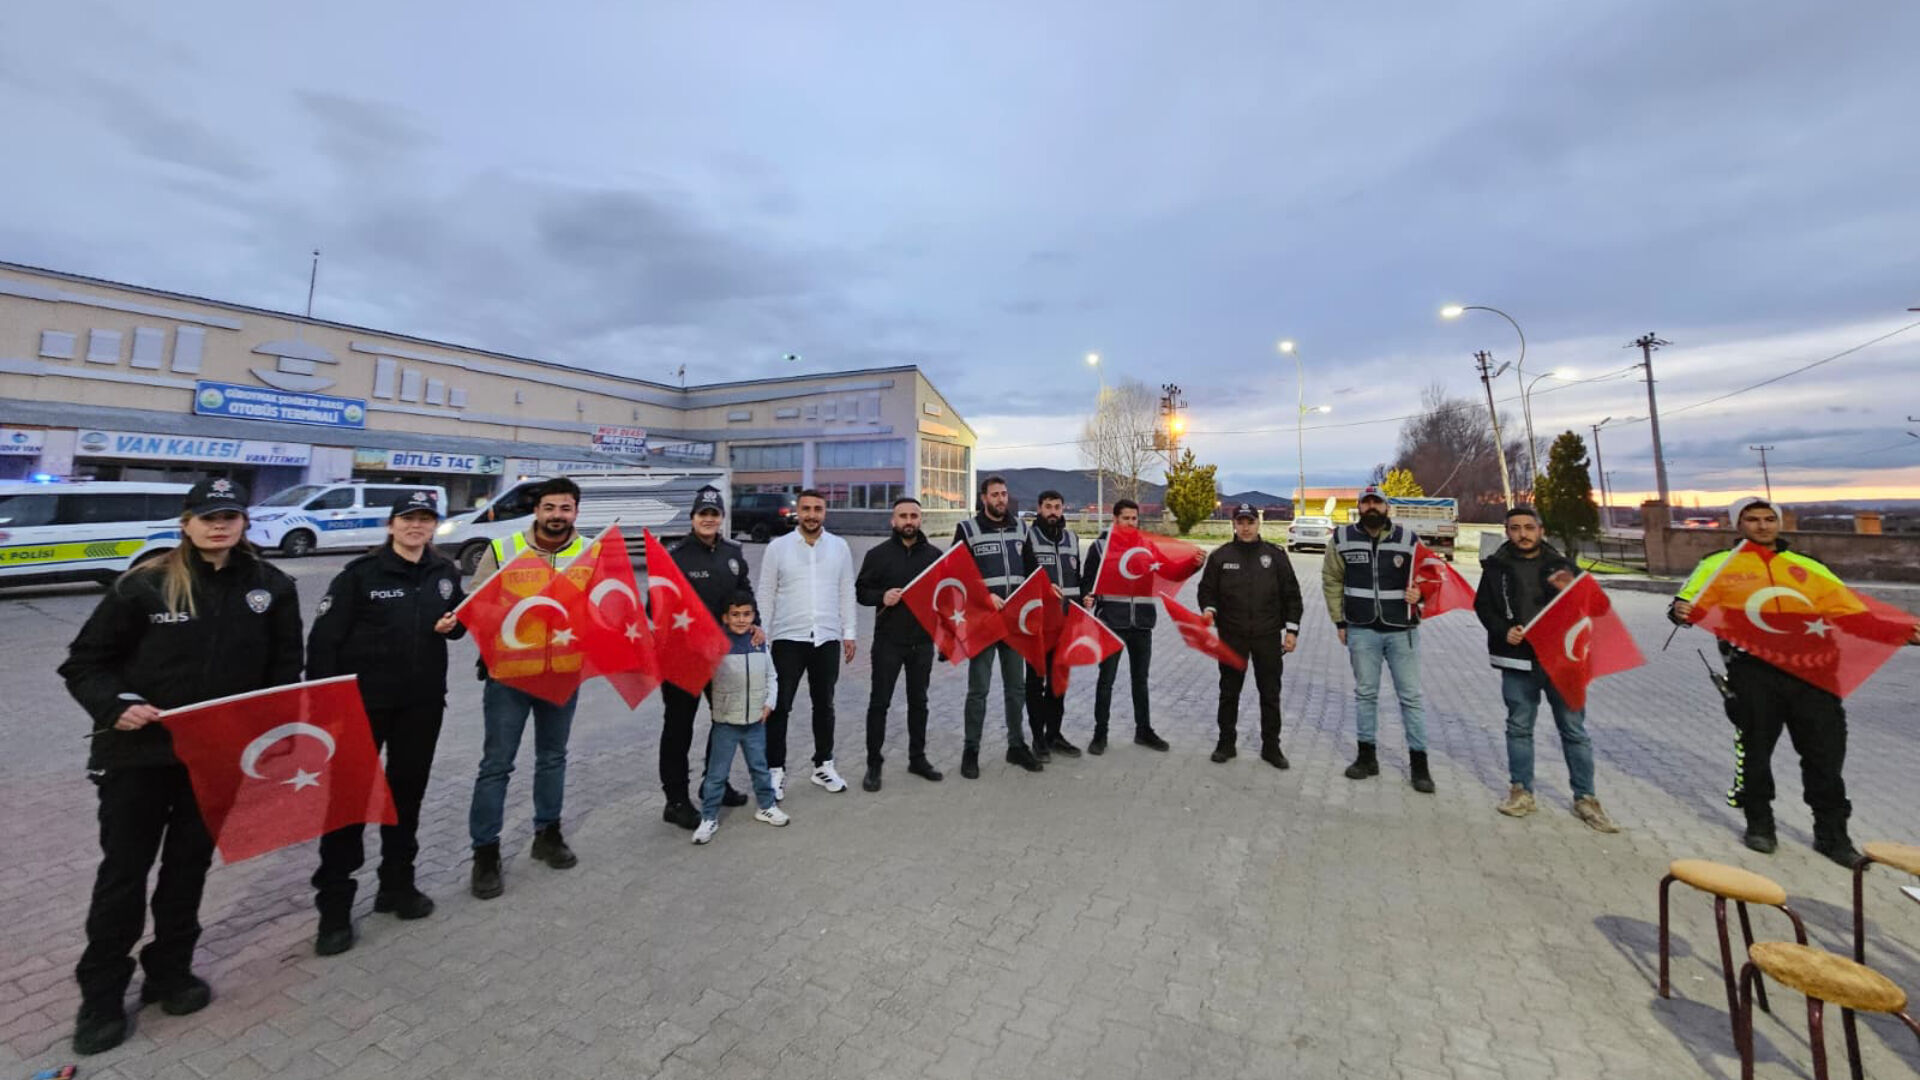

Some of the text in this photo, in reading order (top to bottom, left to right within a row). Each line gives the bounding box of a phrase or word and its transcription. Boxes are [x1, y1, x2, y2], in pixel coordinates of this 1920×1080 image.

[229, 402, 339, 423] OTOBÜS TERMİNALİ
[116, 435, 243, 458] VAN KALESİ
[603, 436, 644, 446] METRO
[245, 454, 267, 463] VAN
[393, 452, 442, 468] BİTLİS
